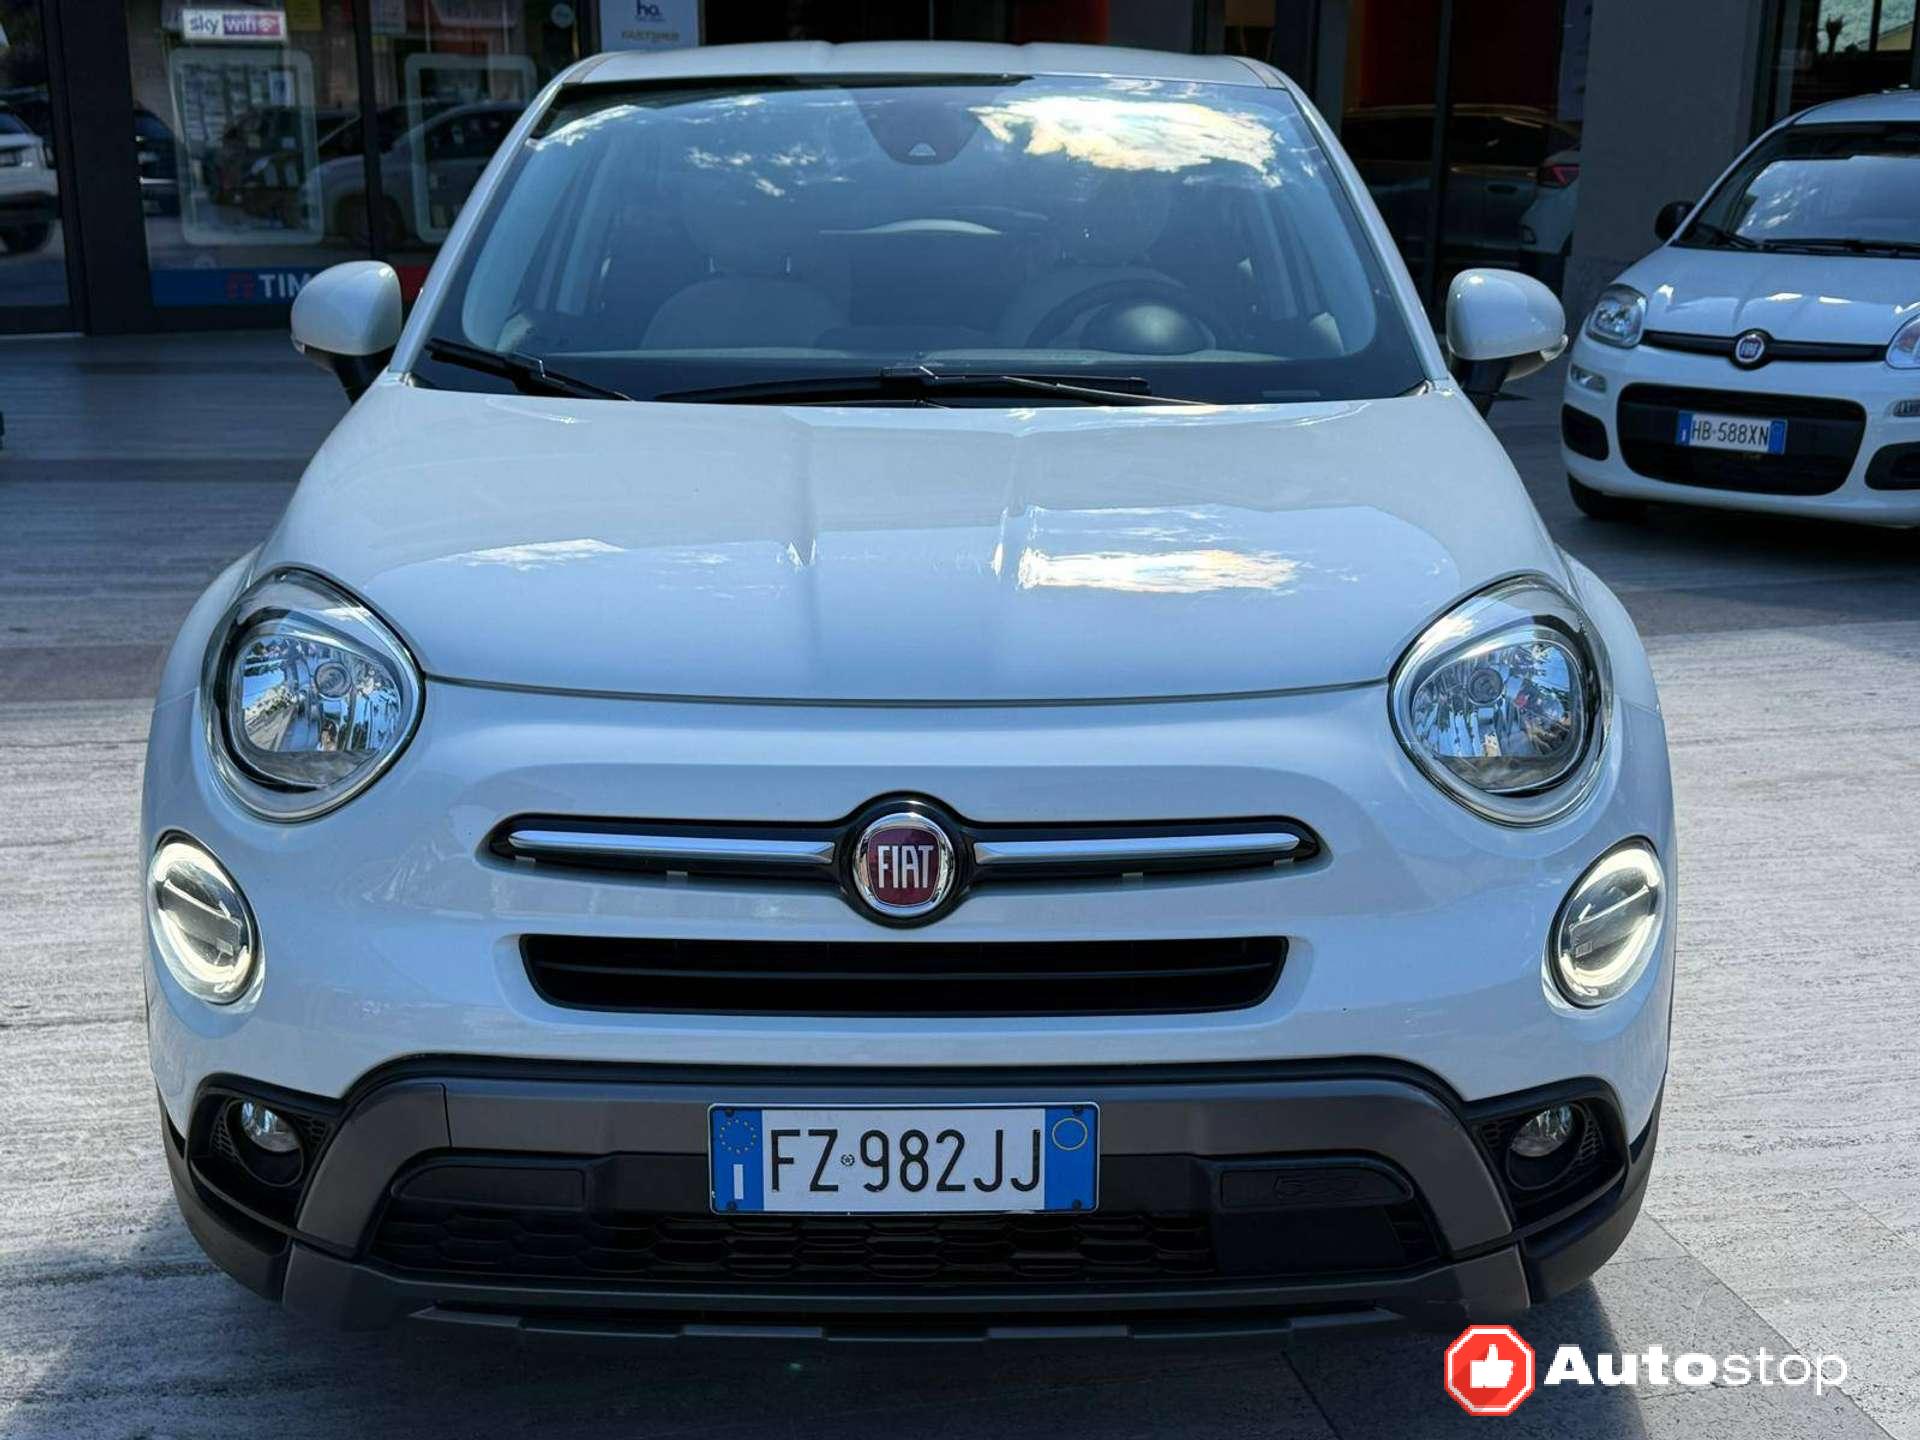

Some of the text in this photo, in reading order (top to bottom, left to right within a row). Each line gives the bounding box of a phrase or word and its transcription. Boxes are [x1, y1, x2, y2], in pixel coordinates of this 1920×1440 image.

[190, 15, 256, 34] sky wifi
[877, 845, 934, 889] FIAT
